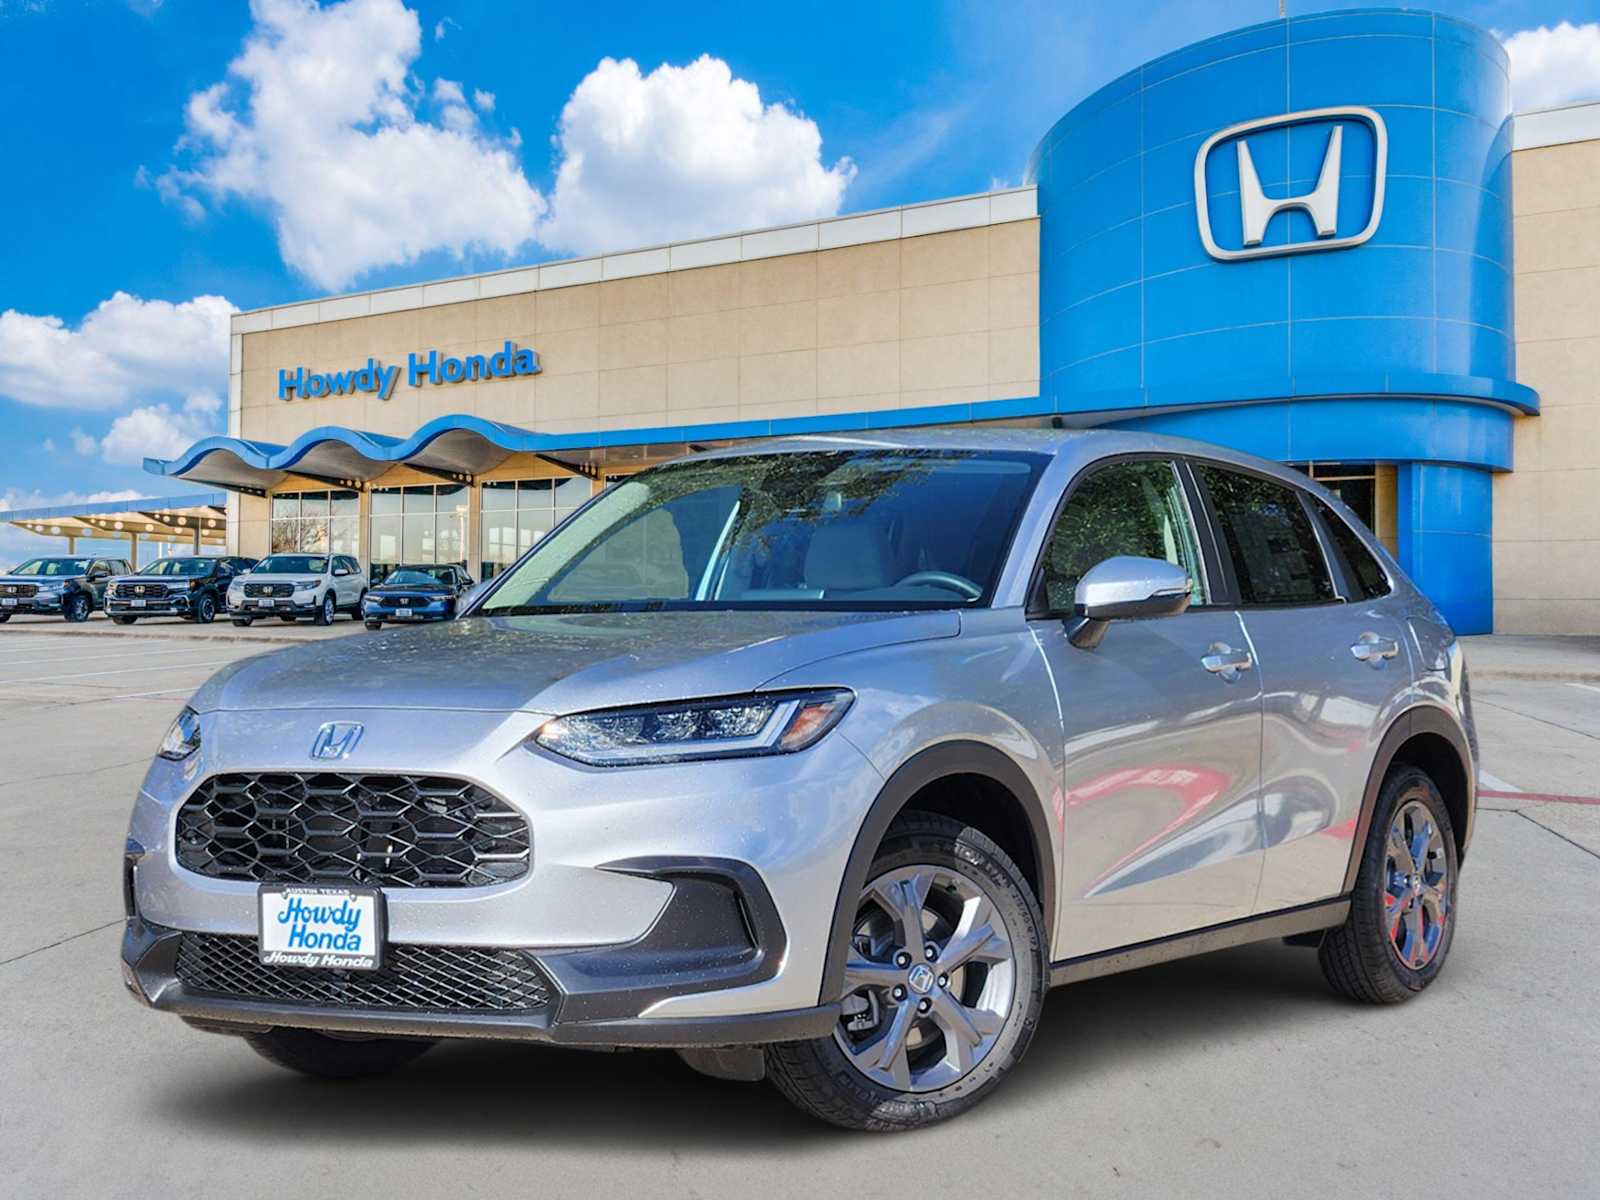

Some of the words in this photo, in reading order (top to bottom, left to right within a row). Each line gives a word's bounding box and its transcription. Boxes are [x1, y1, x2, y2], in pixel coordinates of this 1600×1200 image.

[278, 357, 401, 401] Howdy
[407, 340, 542, 388] Honda
[286, 888, 318, 896] AUSTIN
[320, 888, 350, 896] TEXAS
[277, 897, 361, 932] Howdy
[288, 923, 362, 951] Honda
[263, 951, 320, 968] Howdy
[320, 954, 374, 968] Honda
